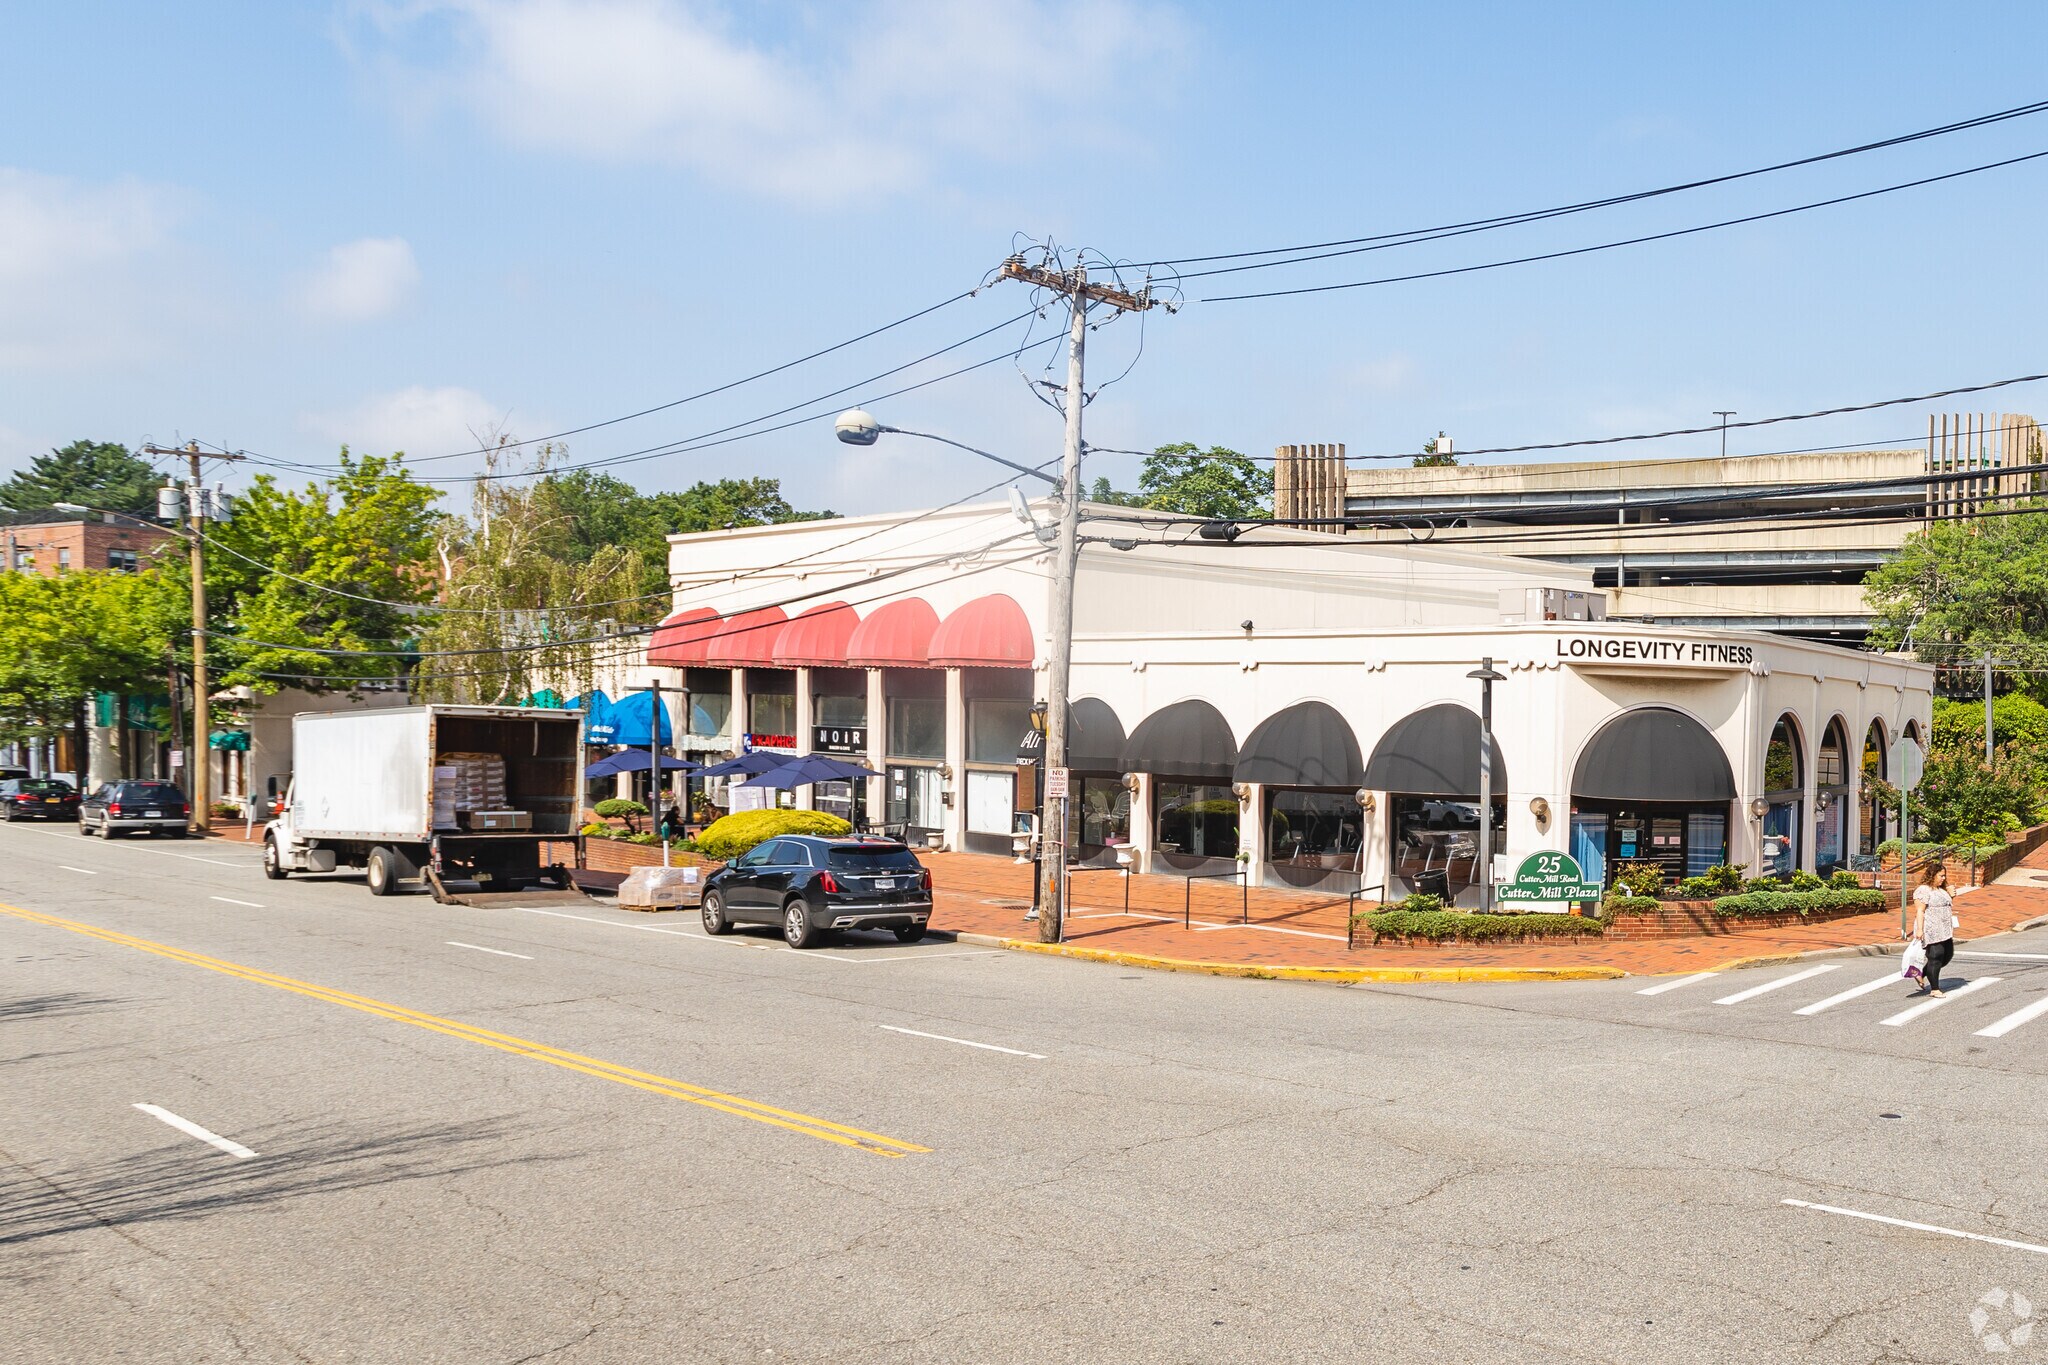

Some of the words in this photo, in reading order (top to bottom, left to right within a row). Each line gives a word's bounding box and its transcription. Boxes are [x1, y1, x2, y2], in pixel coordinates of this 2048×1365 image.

[1557, 638, 1685, 660] LONGEVITY
[1691, 643, 1753, 664] FITNESS
[820, 729, 860, 744] NOIR
[1536, 855, 1562, 873] 25
[1519, 874, 1541, 883] Cutter
[1539, 874, 1558, 883] Mill
[1559, 874, 1578, 883] Road
[1499, 886, 1532, 898] Cutter
[1531, 886, 1561, 899] Mill
[1563, 885, 1598, 899] Plaza
